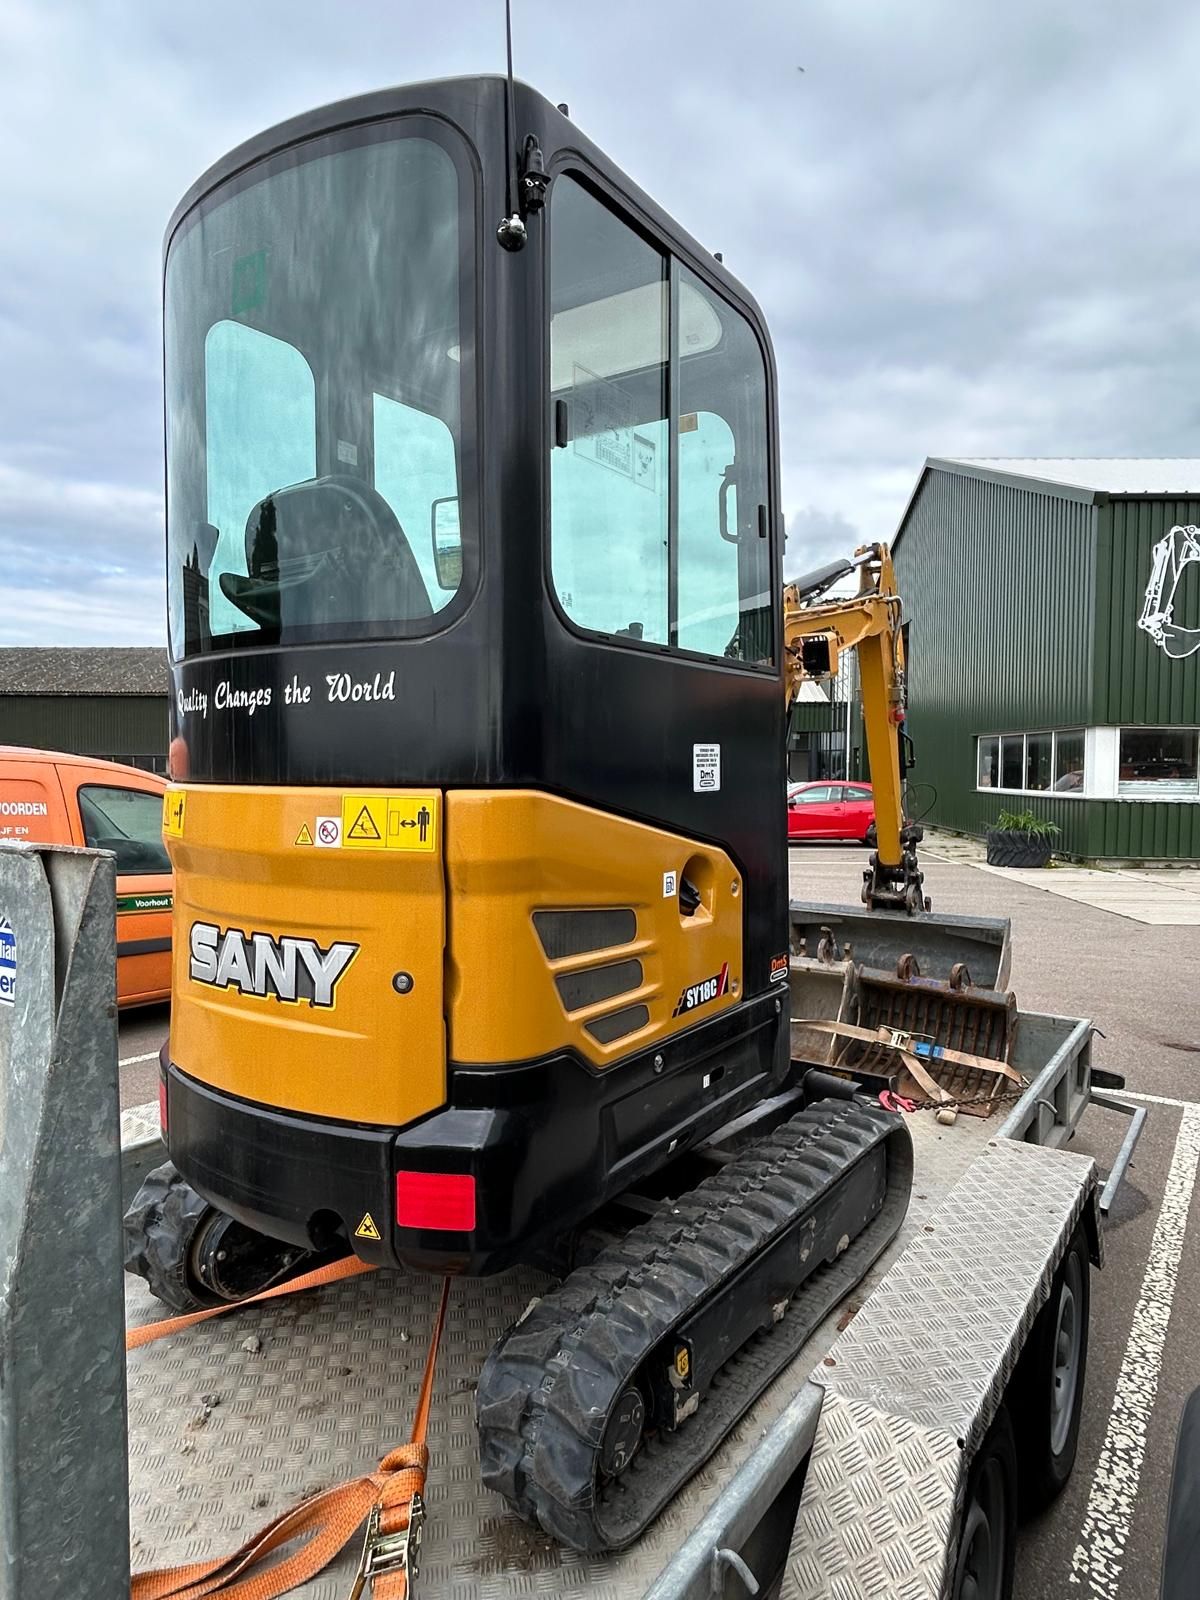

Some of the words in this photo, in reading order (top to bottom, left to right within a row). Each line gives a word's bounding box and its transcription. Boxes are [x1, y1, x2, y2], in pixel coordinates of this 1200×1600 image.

[177, 687, 208, 719] Quality
[214, 681, 272, 716] Changes
[284, 675, 312, 704] the
[325, 671, 396, 703] World
[0, 802, 48, 816] OORDEN
[15, 826, 29, 835] EN
[135, 898, 168, 907] Voorhout
[189, 921, 360, 1008] SANY
[686, 978, 718, 1008] SY18C
